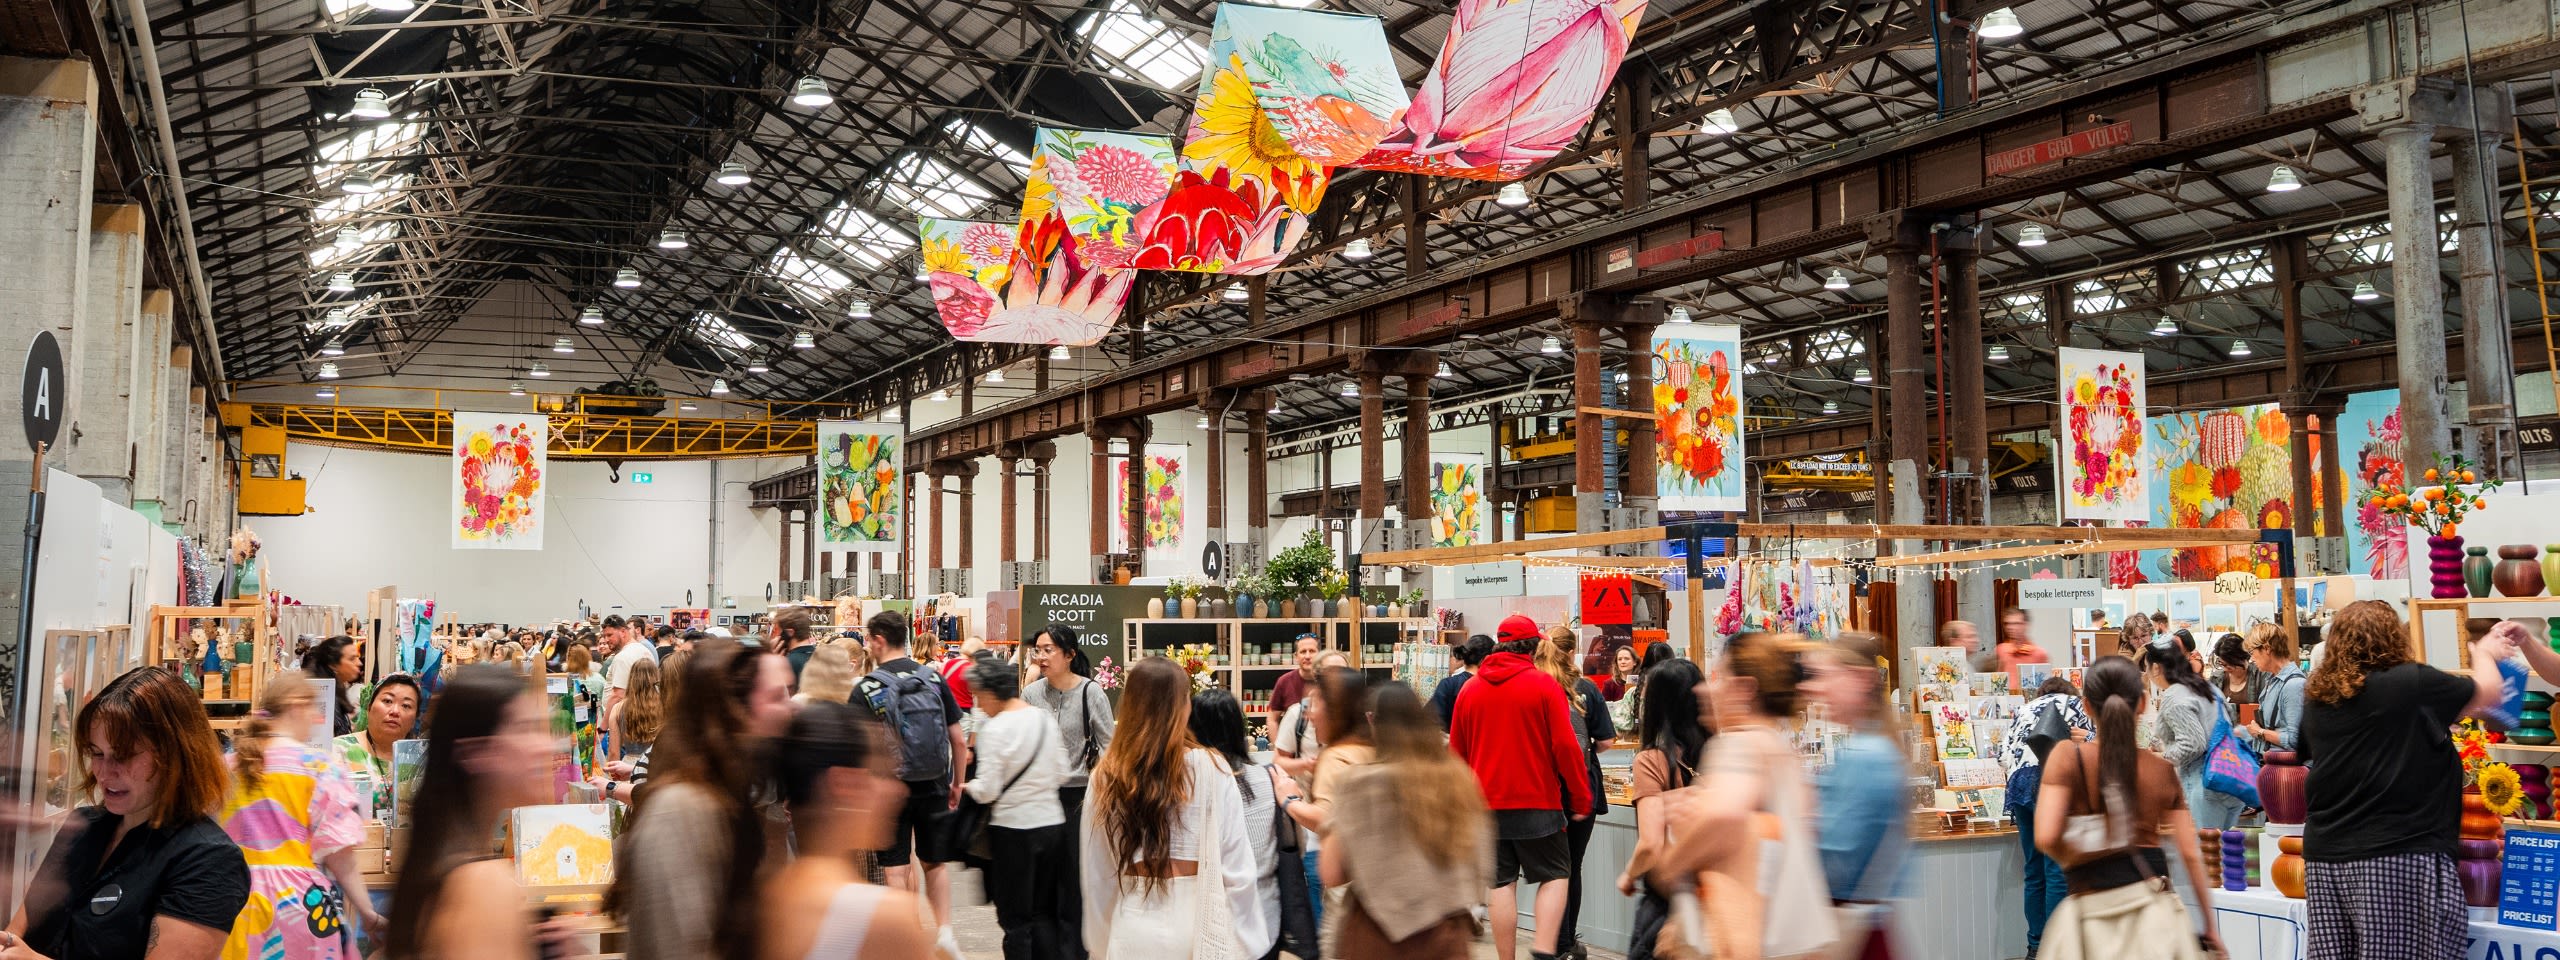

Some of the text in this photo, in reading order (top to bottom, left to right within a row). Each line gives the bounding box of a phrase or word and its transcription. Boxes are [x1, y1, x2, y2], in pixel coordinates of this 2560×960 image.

[1987, 125, 2130, 175] DANGER 600 VOLTS
[33, 367, 50, 420] A
[2519, 428, 2553, 444] OLTS
[2012, 475, 2037, 487] VOLTS
[1850, 490, 1875, 502] DANGE
[1785, 497, 1807, 508] VOLTS
[1208, 552, 1216, 570] A
[1465, 576, 1508, 587] bespoke letterpress
[2214, 575, 2236, 596] BEAU
[1040, 594, 1104, 606] ARCADIA
[2025, 588, 2094, 600] bespoke letterpress
[1048, 610, 1096, 622] SCOTT
[2509, 836, 2560, 849] PRICE LIST
[2503, 910, 2553, 924] PRICE LIST
